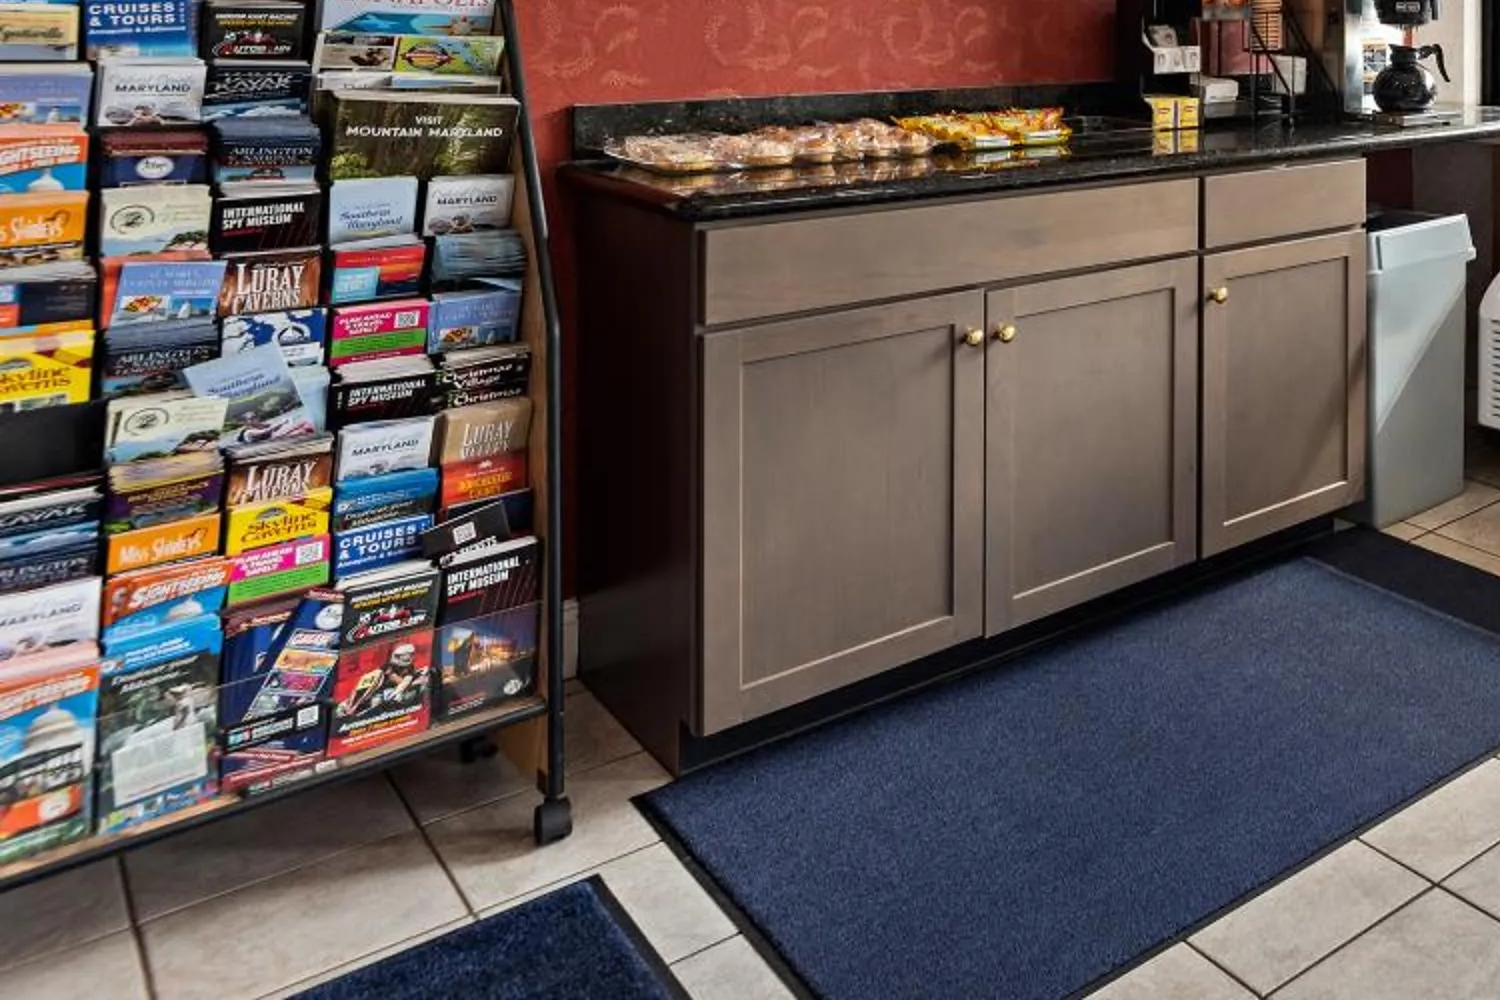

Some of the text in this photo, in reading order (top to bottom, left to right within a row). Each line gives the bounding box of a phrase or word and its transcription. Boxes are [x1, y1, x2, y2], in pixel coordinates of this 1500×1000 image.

[89, 1, 175, 15] CRUISES
[89, 13, 176, 27] & TOURS
[114, 83, 191, 93] MARYLAND
[415, 115, 444, 125] VISIT
[345, 126, 503, 138] MOUNTAIN MARYLAND
[223, 201, 305, 219] INTERNATIONAL
[437, 196, 498, 206] MARYLAND
[223, 214, 292, 231] SPY MUSEUM
[236, 263, 304, 294] LURAY
[233, 289, 301, 315] CAVERNS
[349, 379, 426, 398] INTERNATIONAL
[369, 389, 413, 403] MUSEUM
[463, 421, 512, 446] LURAY
[352, 438, 419, 456] MARYLAND
[247, 461, 317, 495] LURAY
[247, 512, 317, 532] Skyline
[241, 521, 317, 543] Caverns
[339, 524, 417, 549] CRUISES
[338, 535, 416, 560] & TOURS
[447, 556, 520, 585] INTERNATIONAL
[447, 571, 509, 597] SPY MUSEUM
